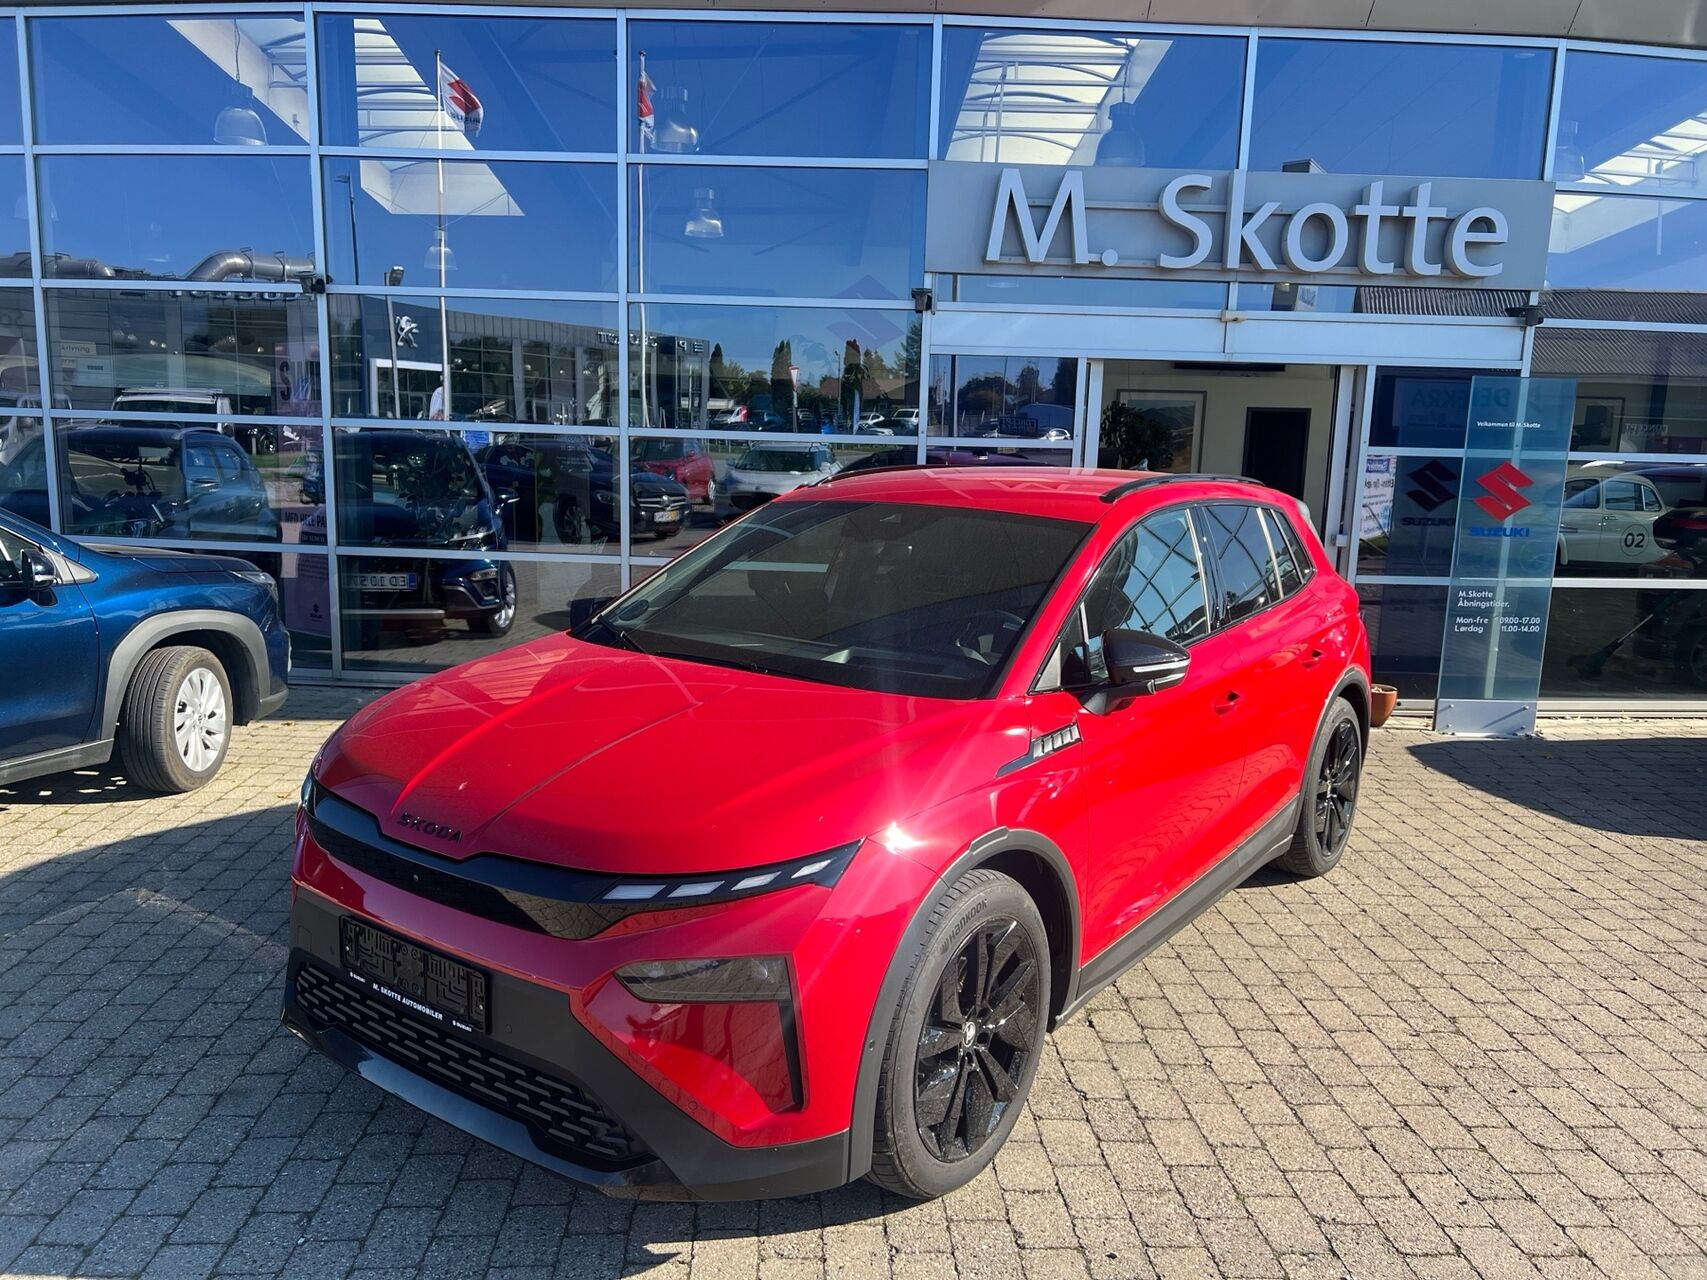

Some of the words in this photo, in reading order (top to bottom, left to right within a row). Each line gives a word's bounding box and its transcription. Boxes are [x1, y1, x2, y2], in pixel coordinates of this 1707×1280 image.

[984, 167, 1119, 267] M.
[1156, 168, 1509, 278] Skotte
[1624, 532, 1646, 550] 02
[380, 986, 401, 1002] SKOTTE
[402, 997, 443, 1021] AUTOMOBILER
